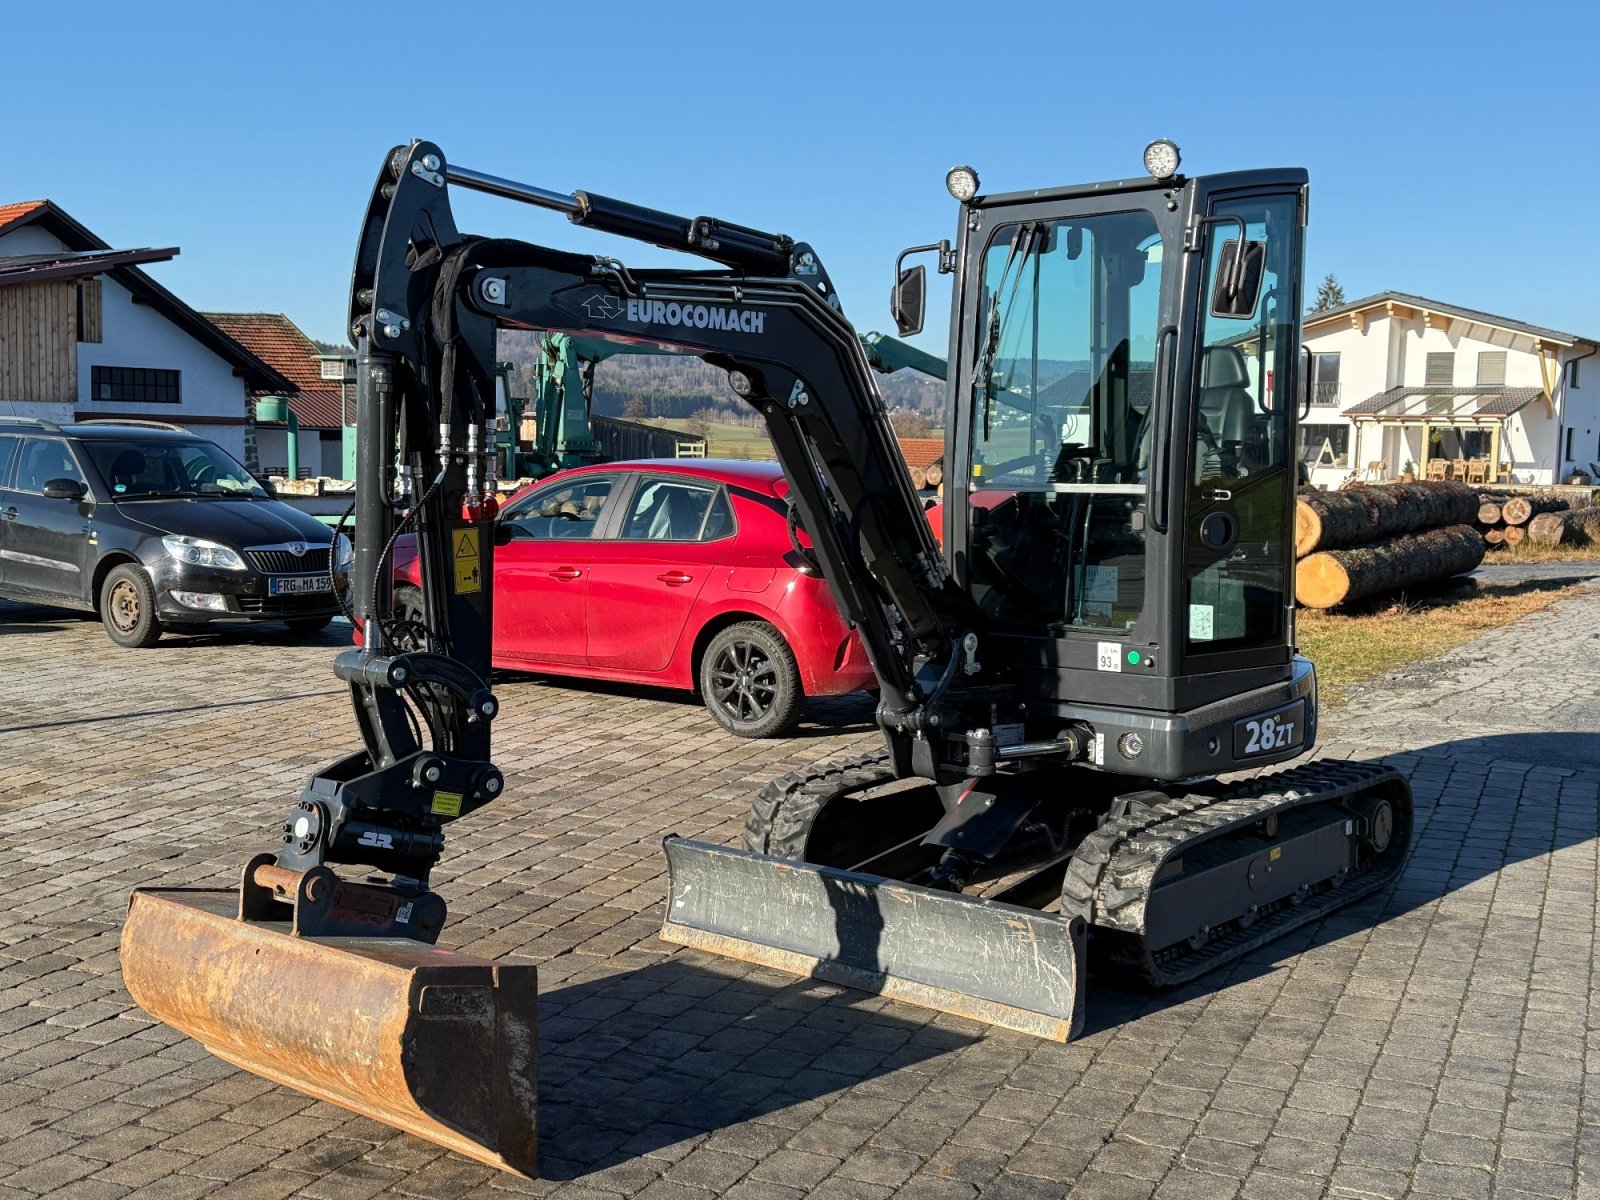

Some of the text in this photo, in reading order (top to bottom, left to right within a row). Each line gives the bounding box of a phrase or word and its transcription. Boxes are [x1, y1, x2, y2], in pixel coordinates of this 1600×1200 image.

[627, 298, 764, 334] EUROCOMACH
[277, 579, 296, 592] FRG
[302, 578, 315, 591] MA
[1100, 655, 1112, 668] 93
[1245, 718, 1295, 753] 28ZT
